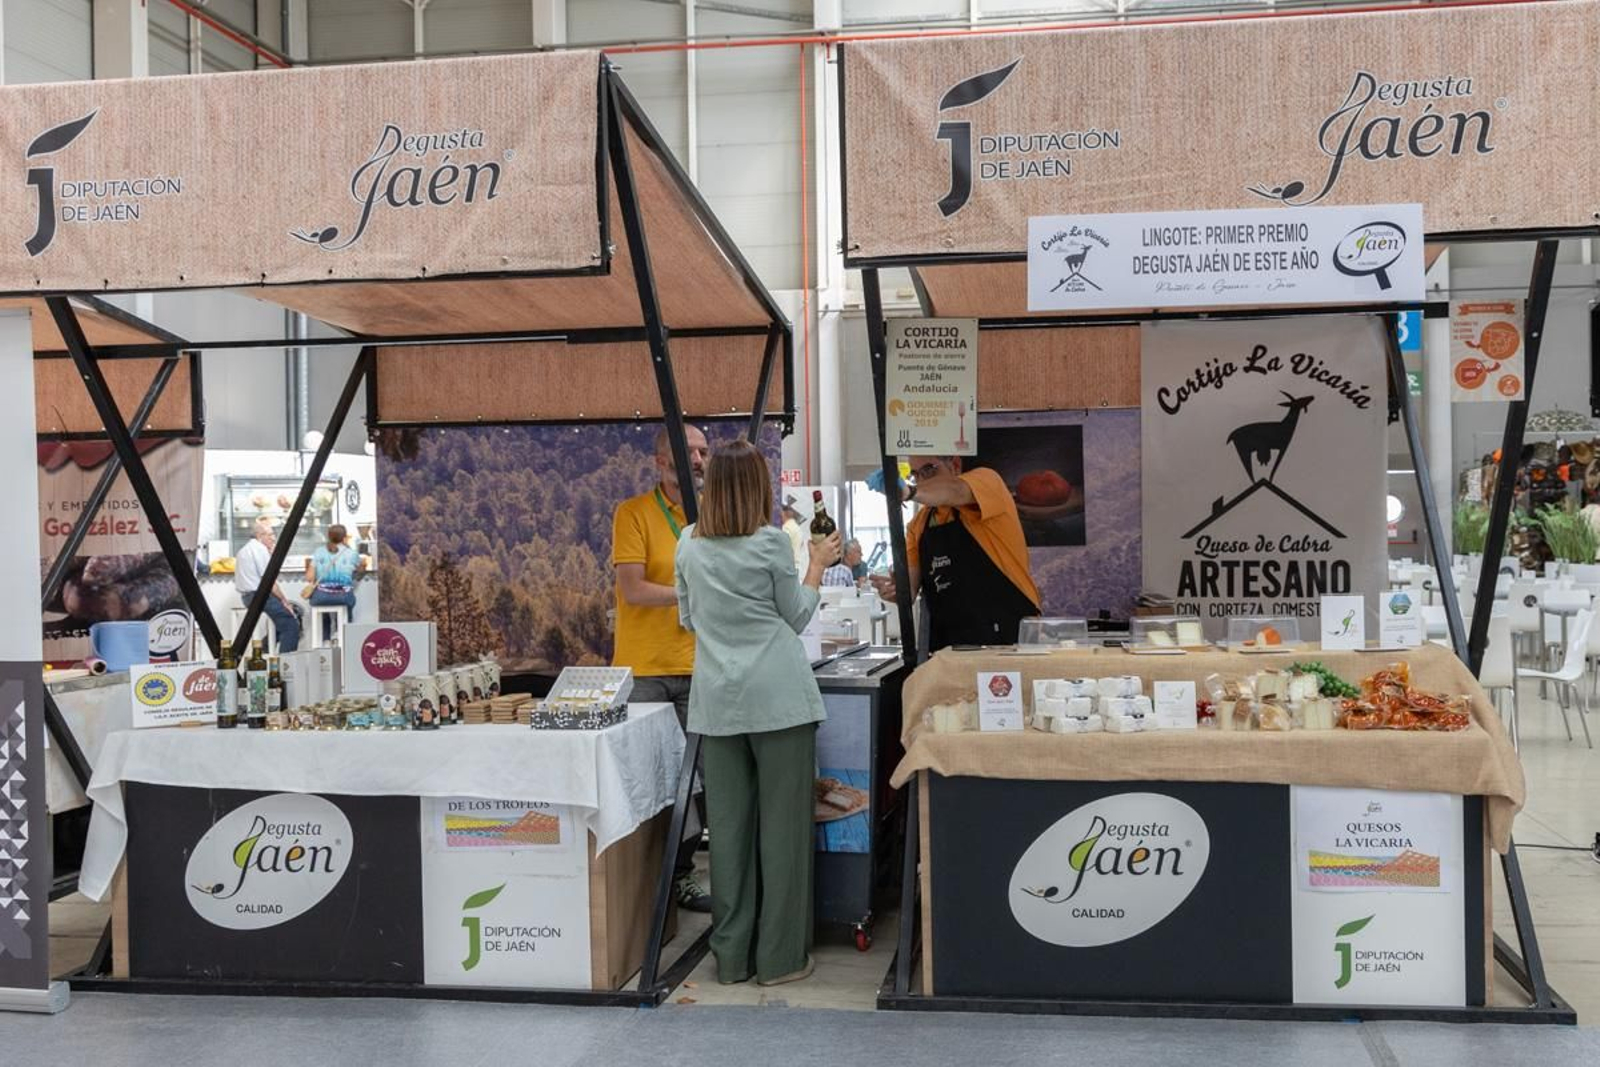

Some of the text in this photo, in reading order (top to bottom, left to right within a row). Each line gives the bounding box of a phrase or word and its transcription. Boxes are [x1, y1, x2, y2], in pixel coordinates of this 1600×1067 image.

[1341, 71, 1473, 107] Degusta
[371, 124, 484, 158] Degusta
[980, 129, 1119, 154] DIPUTACIÓN
[1312, 103, 1494, 205] Jaén
[980, 157, 1071, 179] DE JAÉN
[61, 175, 181, 198] DIPUTACIÓN
[61, 203, 140, 221] DE JAÉN
[346, 155, 501, 250] Jaén
[1142, 223, 1309, 247] LINGOTE: PRIMER PREMIO
[1133, 247, 1319, 275] DEGUSTA JAÉN DE ESTE AÑO
[904, 327, 960, 338] CORTIJO
[896, 339, 967, 349] LA VICARIA
[1157, 357, 1238, 415] Cortijo
[1243, 344, 1283, 375] La
[43, 515, 140, 537] Gozález
[1194, 534, 1333, 558] Queso de Cabra
[1177, 560, 1351, 598] ARTESANO
[1176, 602, 1200, 616] CON
[1272, 602, 1321, 617] COMEST
[448, 800, 551, 812] DE LOS TROFEOS
[248, 815, 322, 839] Degusta
[1083, 815, 1170, 840] Degusta
[1346, 822, 1402, 835] QUESOS
[1335, 837, 1413, 848] LA VICARIA
[226, 839, 336, 899] Jaén
[1063, 840, 1184, 903] Jaén
[235, 904, 284, 914] CALIDAD
[1071, 908, 1125, 919] CALIDAD
[484, 926, 561, 938] DIPUTACIÓN
[484, 940, 536, 952] DE JAÉN
[1355, 949, 1424, 961] DIPUTACIÓN
[1355, 961, 1401, 972] DE JAÉN
